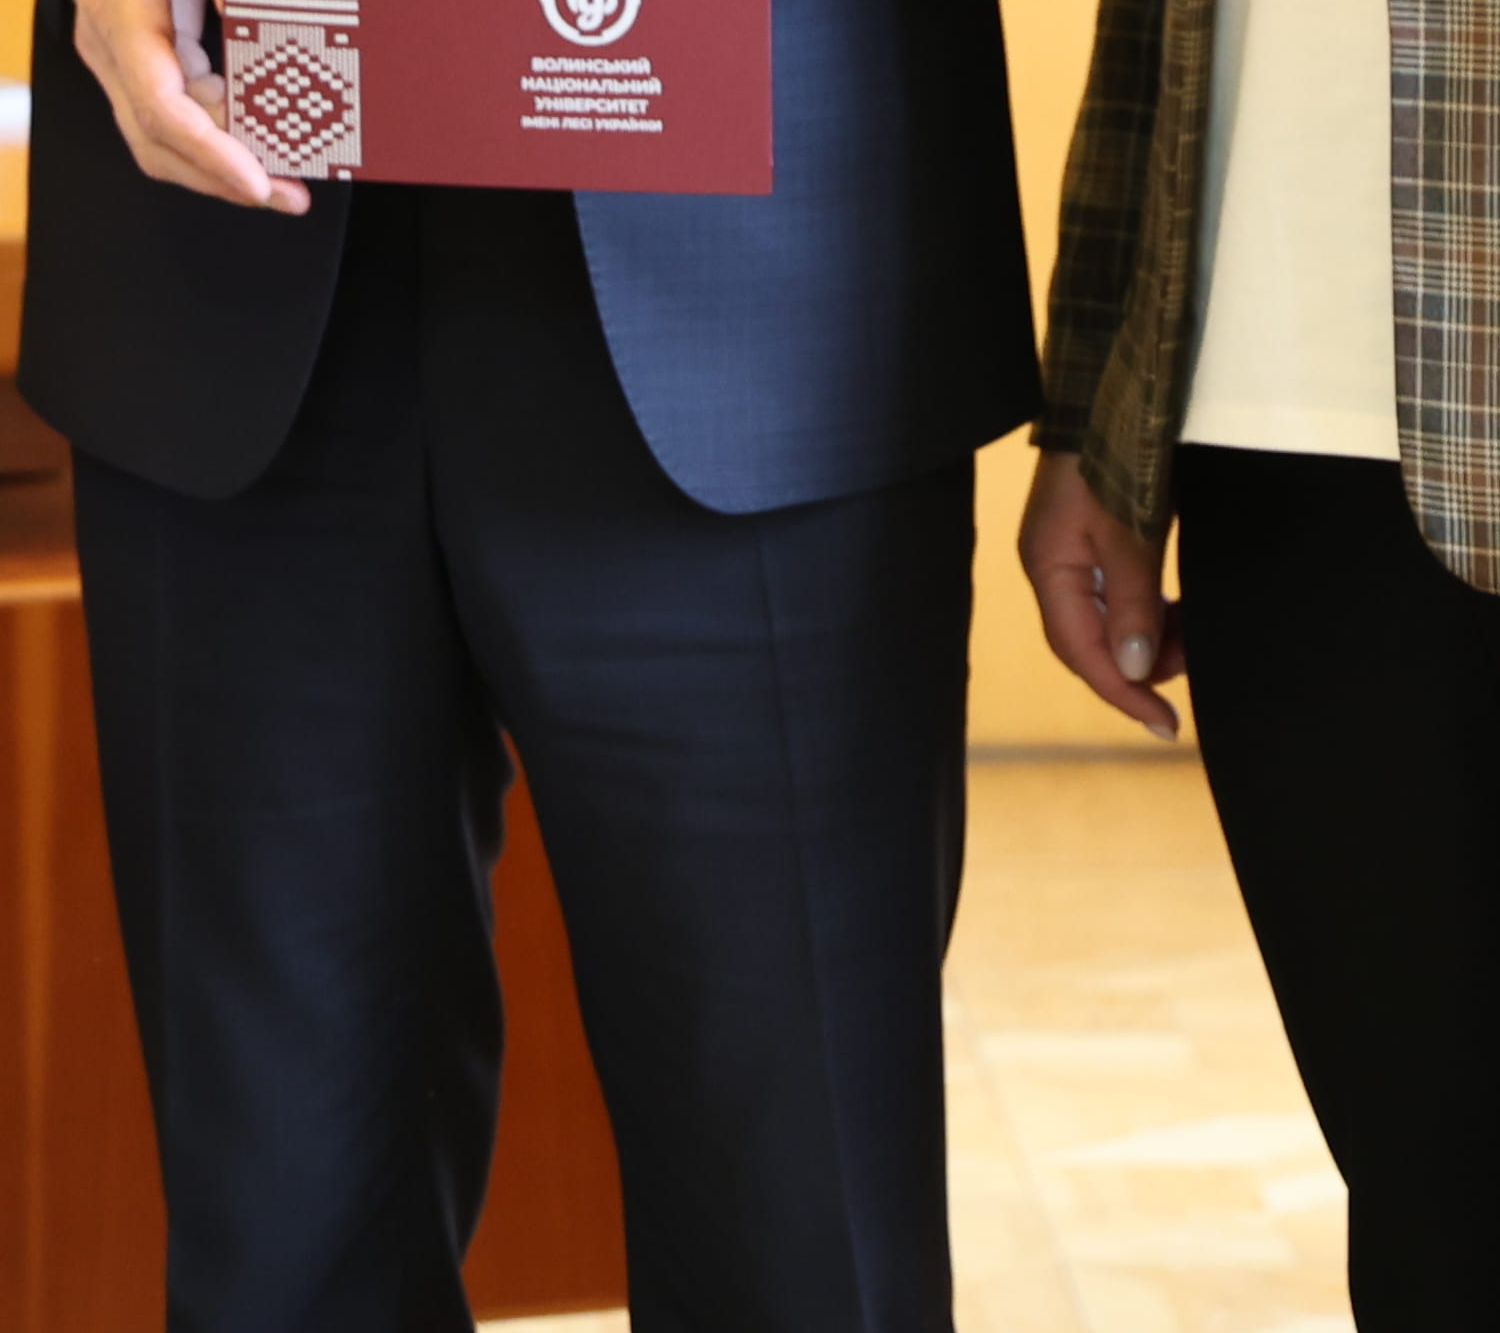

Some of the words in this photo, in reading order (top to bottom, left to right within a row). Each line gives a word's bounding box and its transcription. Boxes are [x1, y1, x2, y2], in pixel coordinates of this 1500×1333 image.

[531, 56, 651, 75] ВОЛИНСЬКИЙ
[521, 76, 662, 95] НАЦІОНАЛЬНИЙ
[534, 96, 649, 114] УНІВЕРСИТЕТ
[521, 115, 560, 129] ІМЕНІ
[562, 116, 593, 130] ЛЕСІ
[595, 117, 663, 133] УКРАЇНИ
